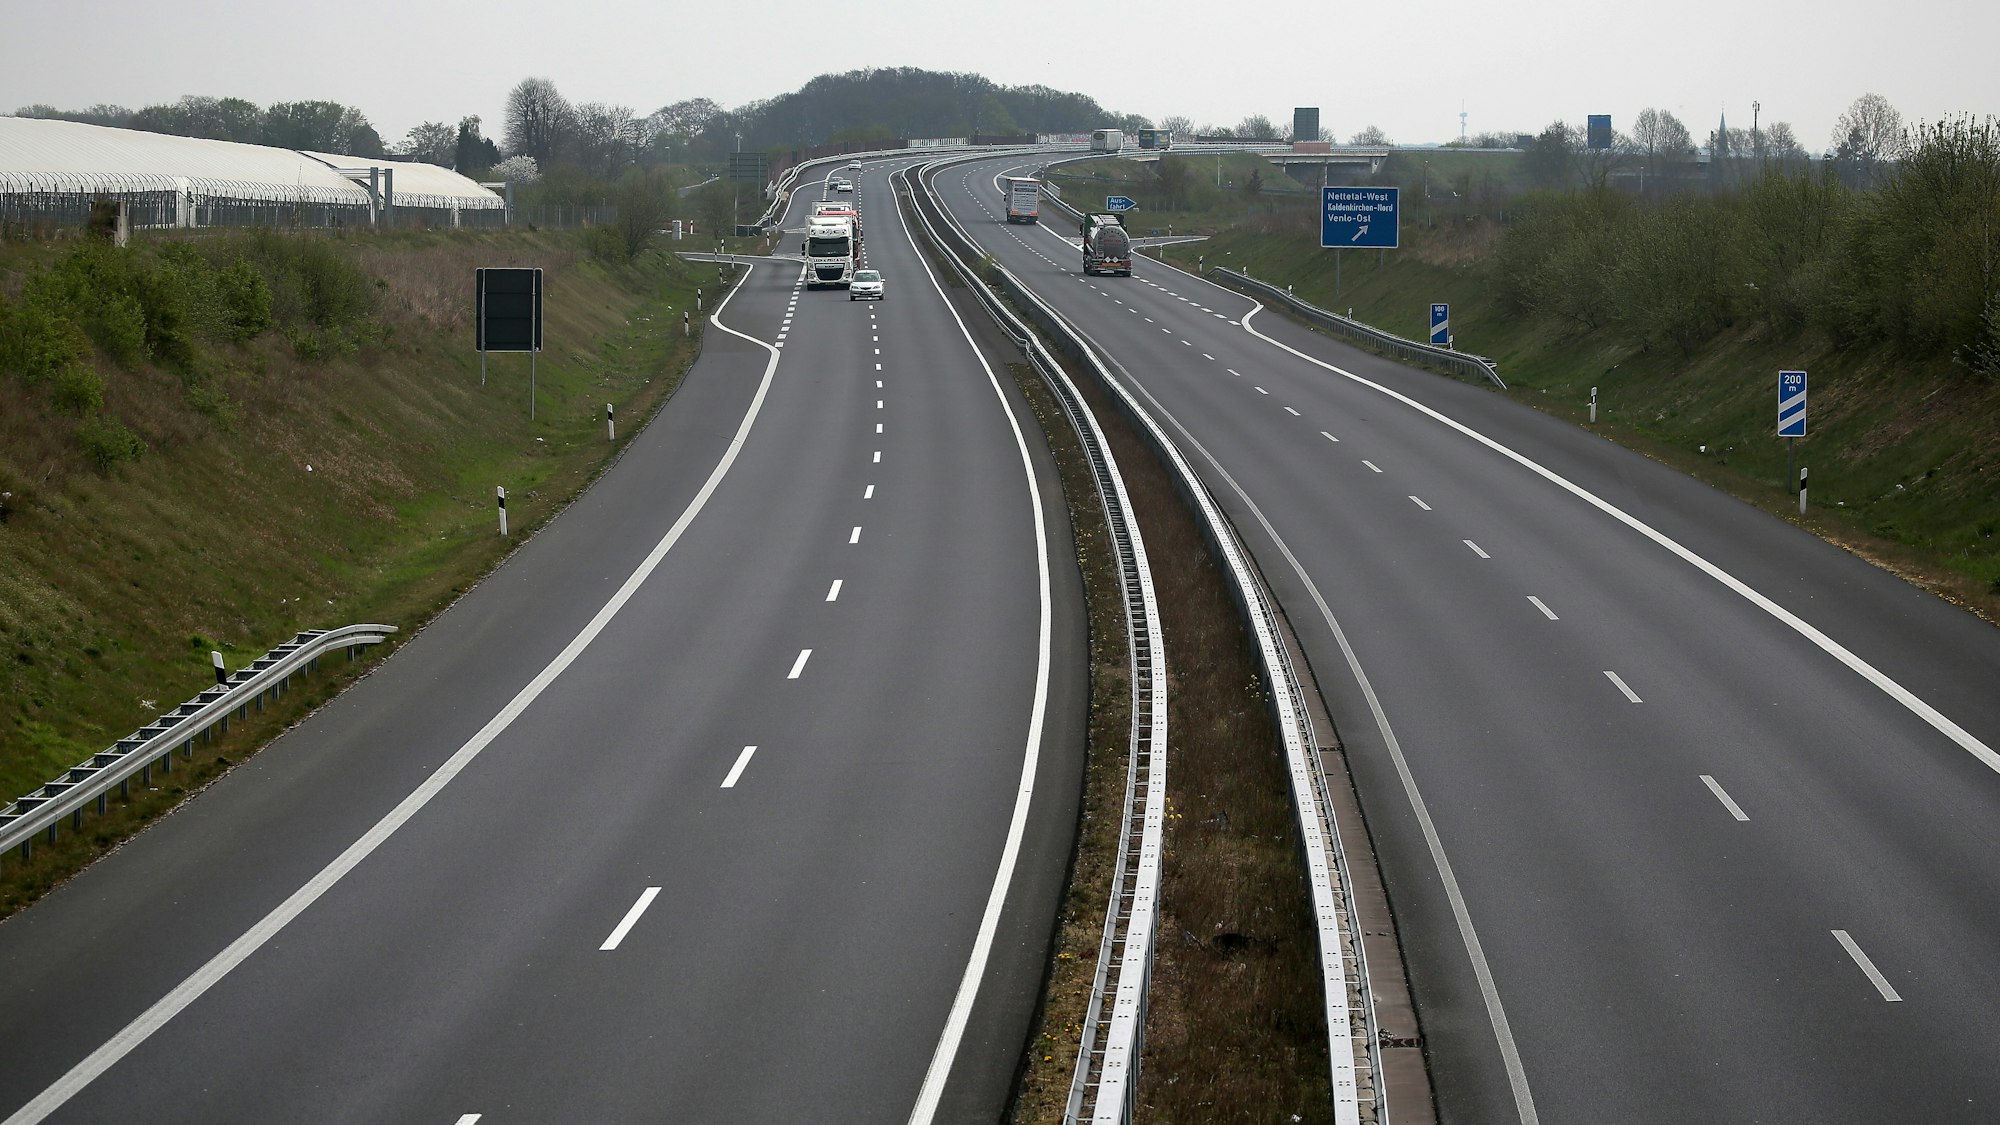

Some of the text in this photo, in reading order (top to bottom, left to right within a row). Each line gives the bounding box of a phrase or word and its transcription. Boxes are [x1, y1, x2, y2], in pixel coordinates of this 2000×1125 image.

[1327, 192, 1388, 201] Nettetal-West
[1327, 203, 1393, 212] Kaldenkirchen-Nord
[1328, 214, 1371, 222] Venlo-Ost
[1784, 375, 1802, 384] 200
